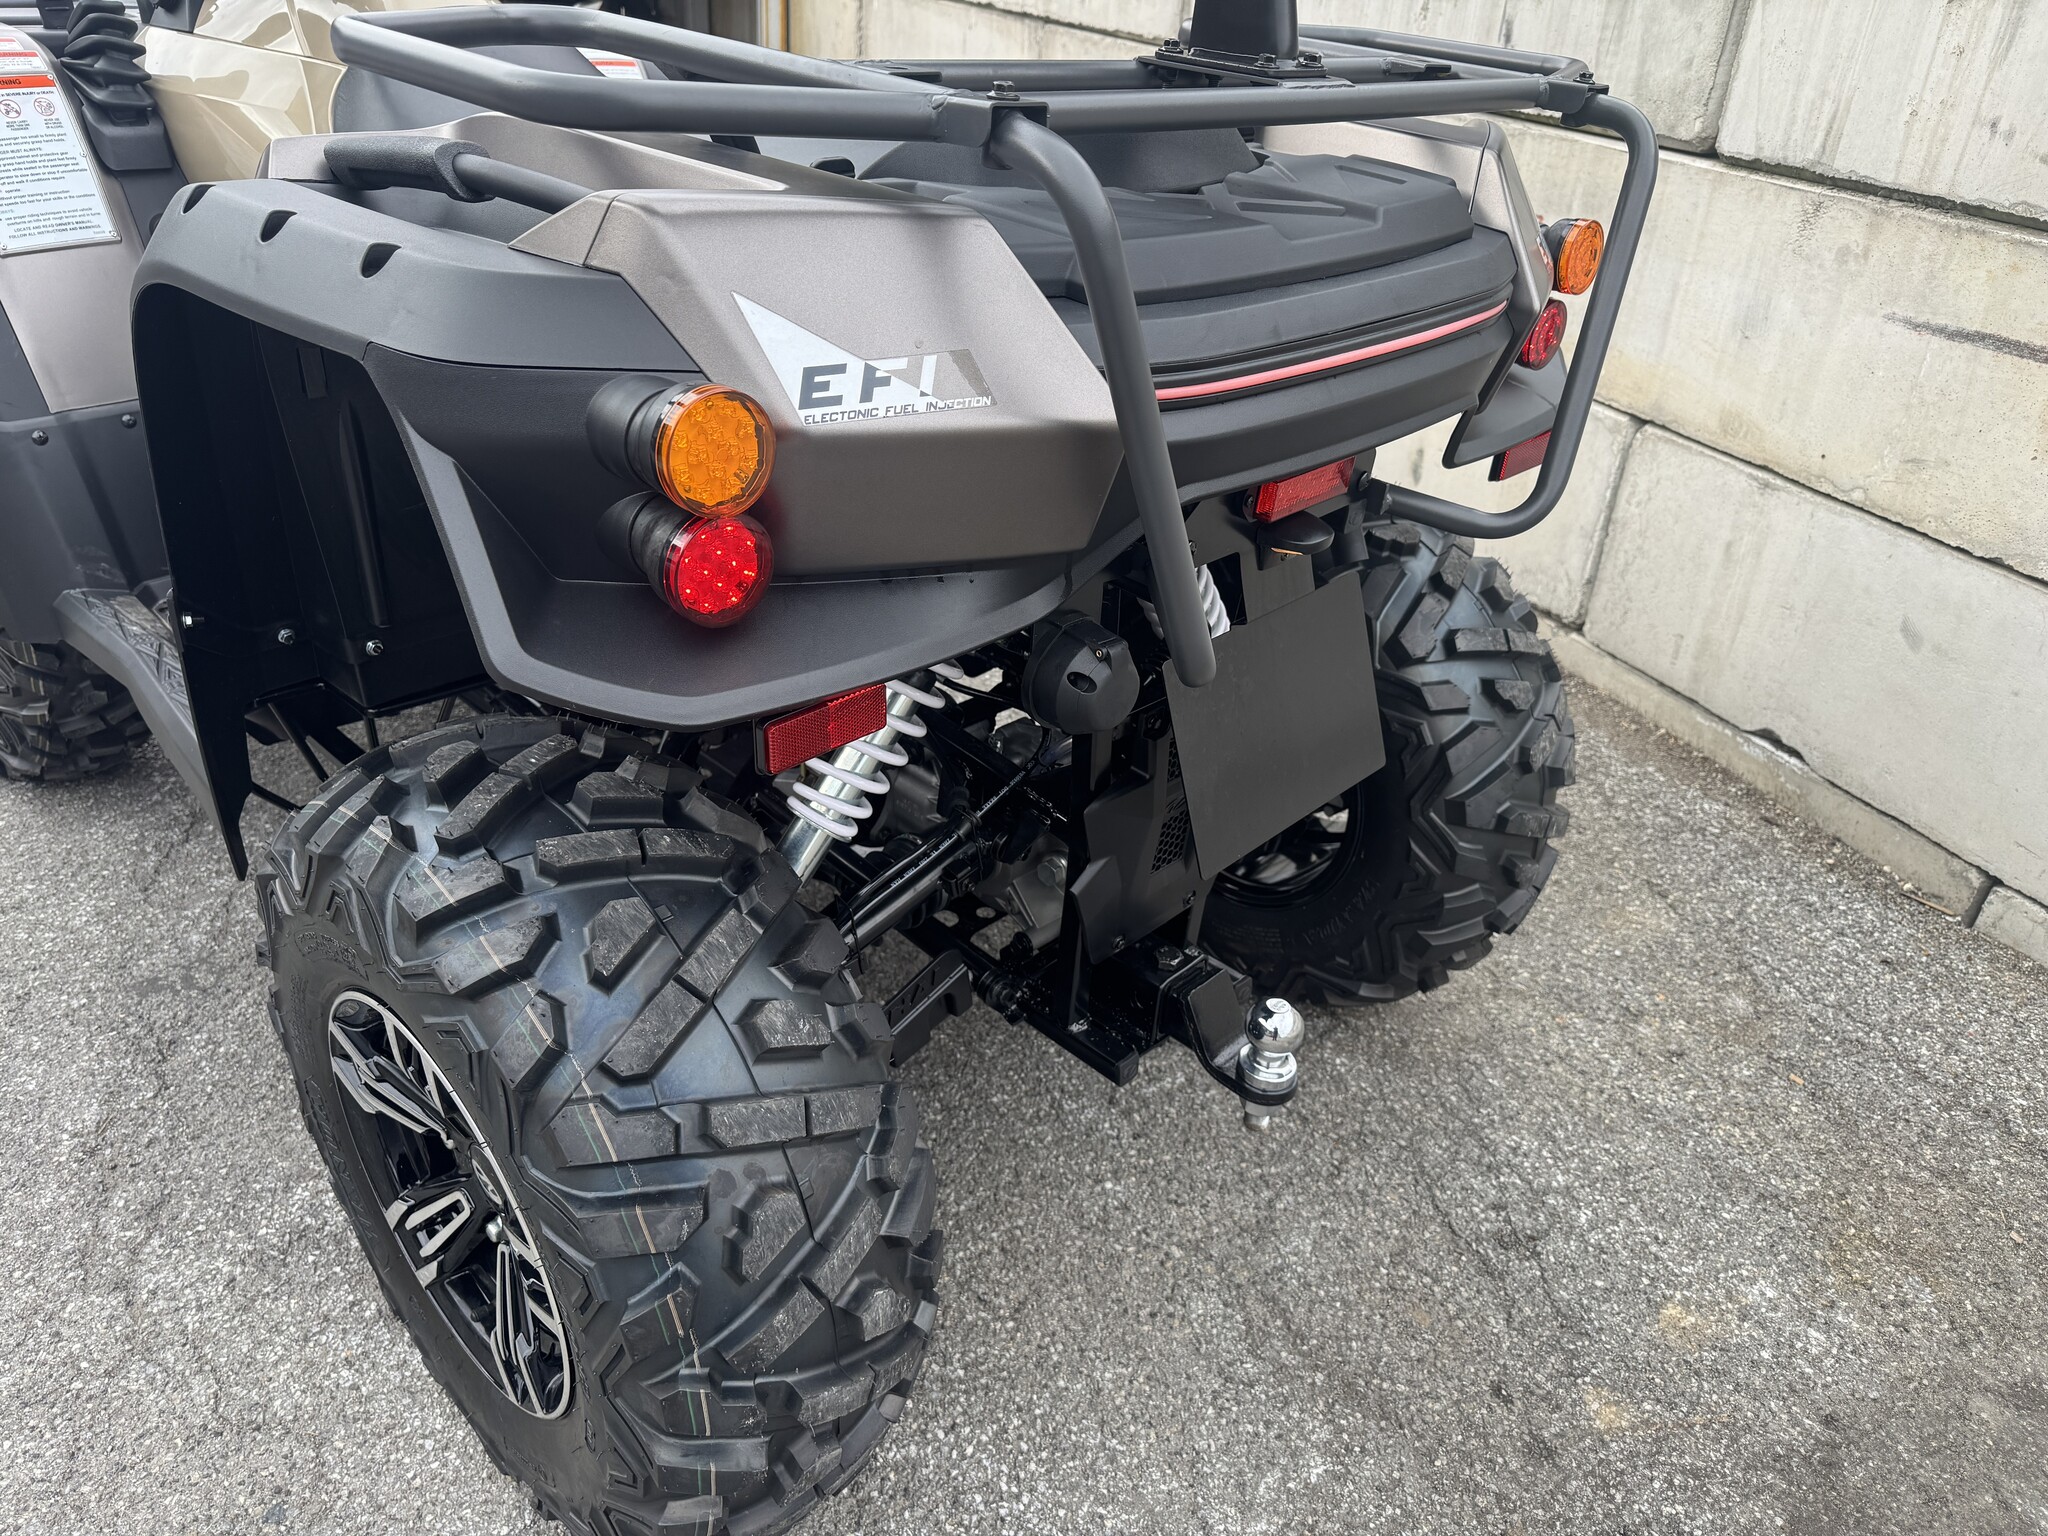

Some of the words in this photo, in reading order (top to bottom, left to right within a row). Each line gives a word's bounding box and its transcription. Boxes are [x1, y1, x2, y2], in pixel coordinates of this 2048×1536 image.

[797, 354, 938, 410] EFI
[804, 407, 880, 425] ELECTONIC
[884, 404, 919, 417] FUEL
[925, 396, 992, 412] INJECTION
